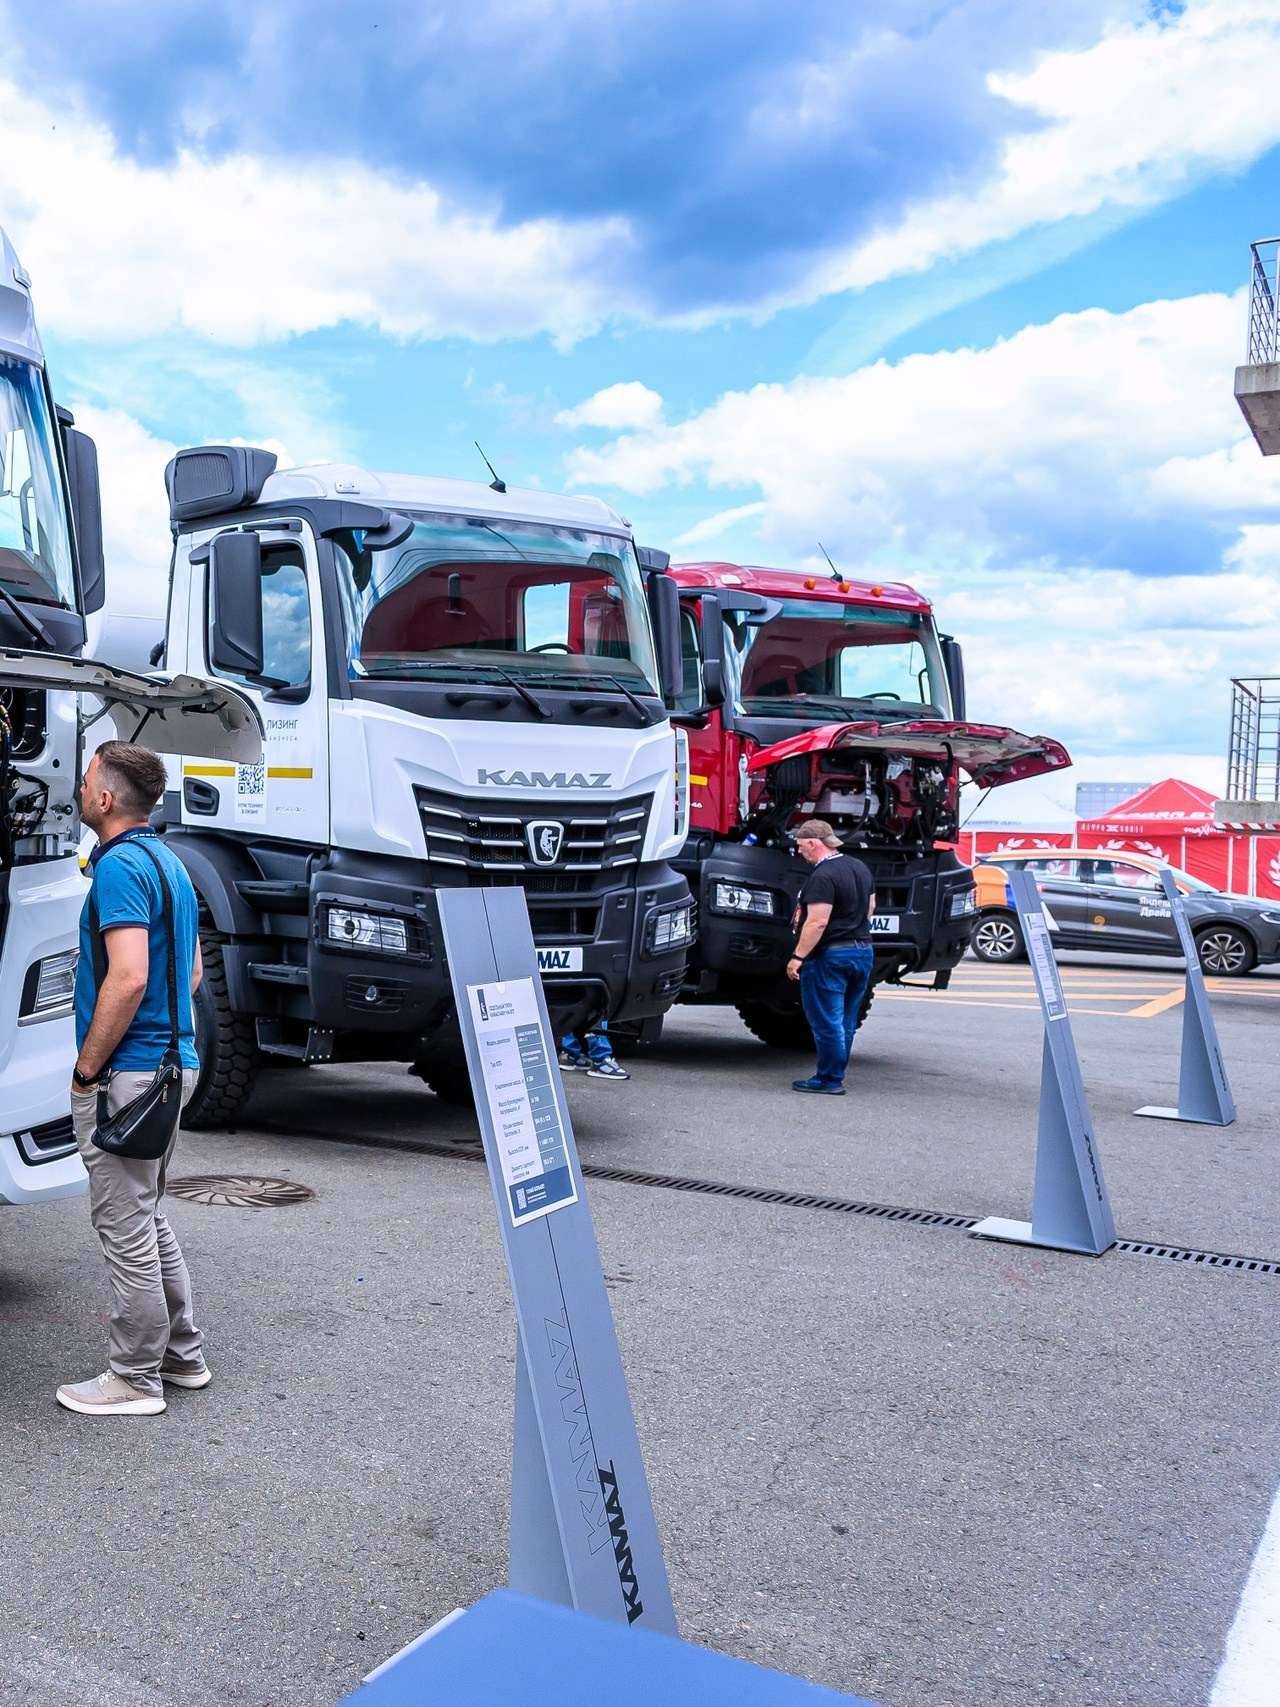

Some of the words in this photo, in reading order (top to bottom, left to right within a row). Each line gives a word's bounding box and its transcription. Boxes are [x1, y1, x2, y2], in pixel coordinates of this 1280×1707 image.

[266, 719, 298, 730] ЛИЗИНГ
[477, 768, 612, 788] KAMAZ
[544, 1307, 613, 1556] KAMAZ
[597, 1459, 643, 1627] KAMAZ
